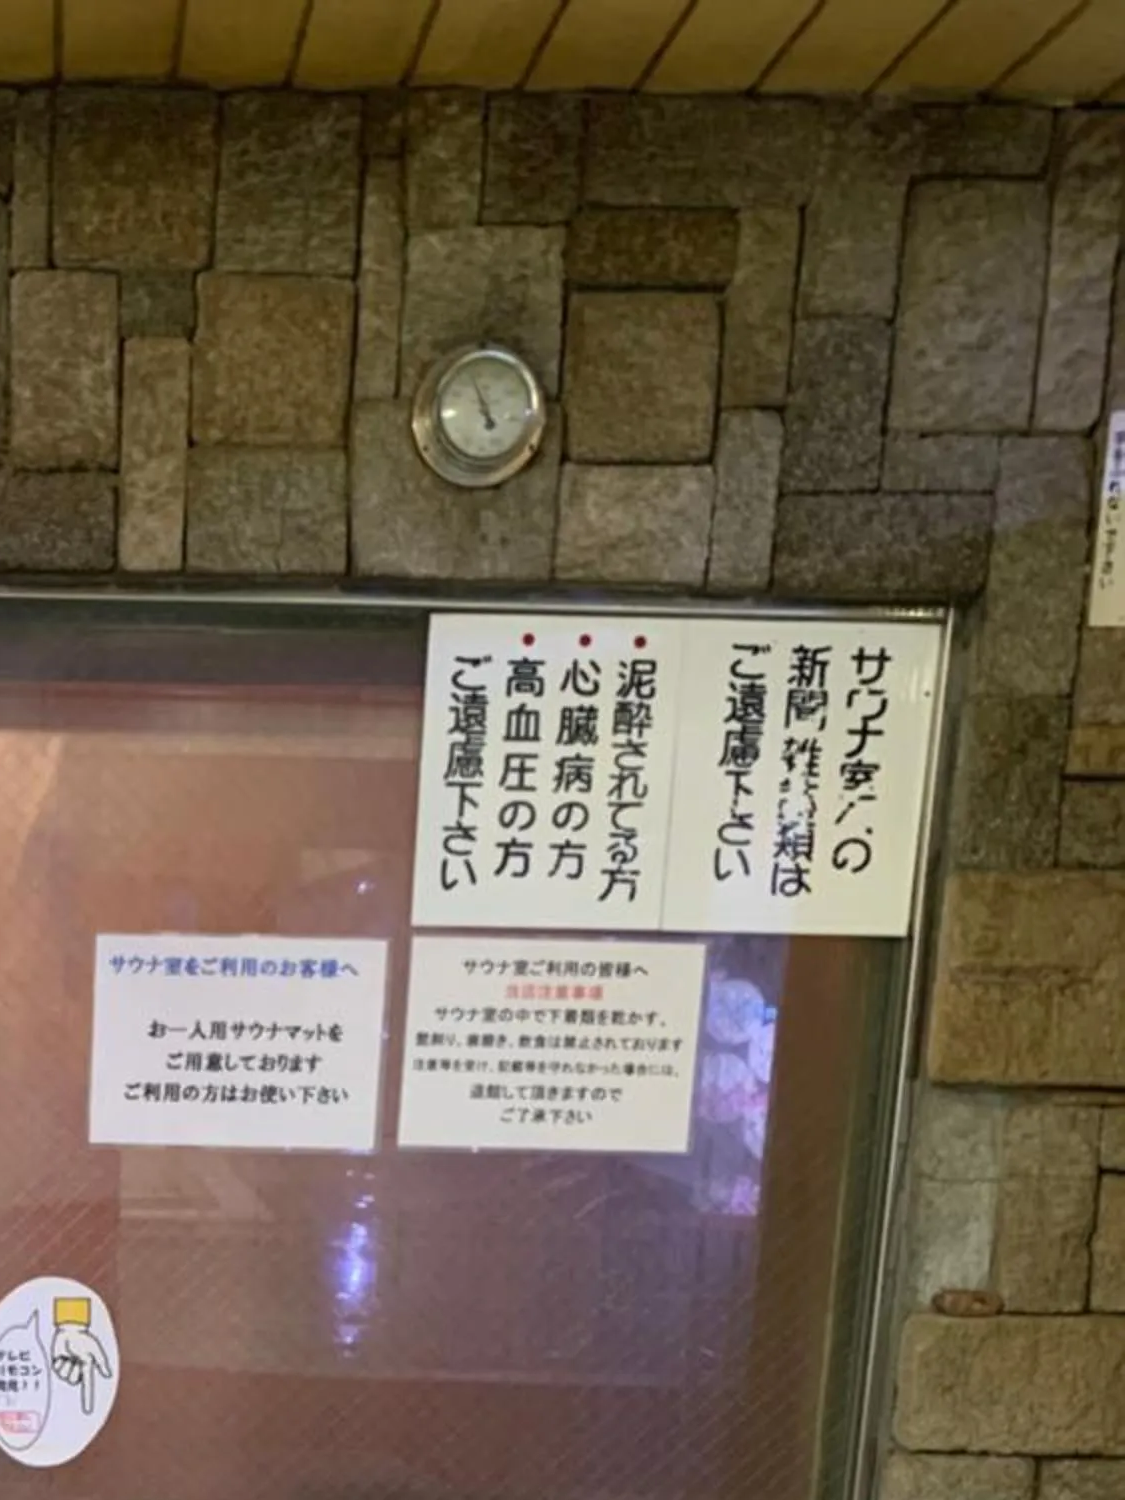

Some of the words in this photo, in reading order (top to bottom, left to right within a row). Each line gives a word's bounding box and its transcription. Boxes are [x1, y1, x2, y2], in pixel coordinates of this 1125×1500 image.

[439, 655, 493, 892] ご遠慮下さい
[493, 656, 546, 879] 高血圧の方
[547, 660, 602, 880] 心臓病の方
[597, 658, 658, 903] 泥酔されてる方
[713, 642, 772, 881] ご遠慮下さい
[109, 955, 360, 980] サウナ室をご利用のお客様へ
[463, 958, 649, 979] サウナ室ご利用の皆様へ
[148, 1019, 344, 1042] お一人用サウナマットを
[166, 1051, 323, 1073] ご用意しております
[124, 1082, 349, 1105] ご利用の方はお使い下さい
